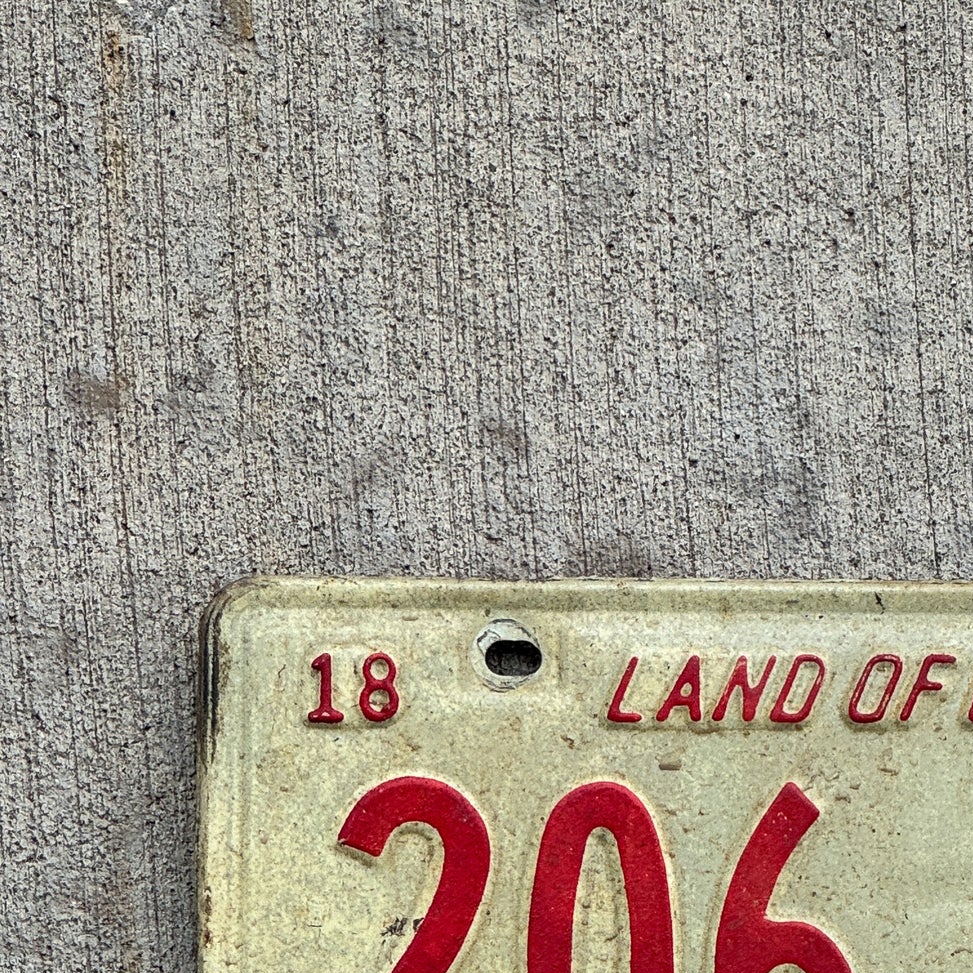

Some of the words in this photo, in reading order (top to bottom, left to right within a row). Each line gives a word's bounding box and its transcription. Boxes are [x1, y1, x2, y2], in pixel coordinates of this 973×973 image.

[306, 652, 401, 724] 18
[606, 655, 826, 725] LAND
[847, 653, 958, 724] OF
